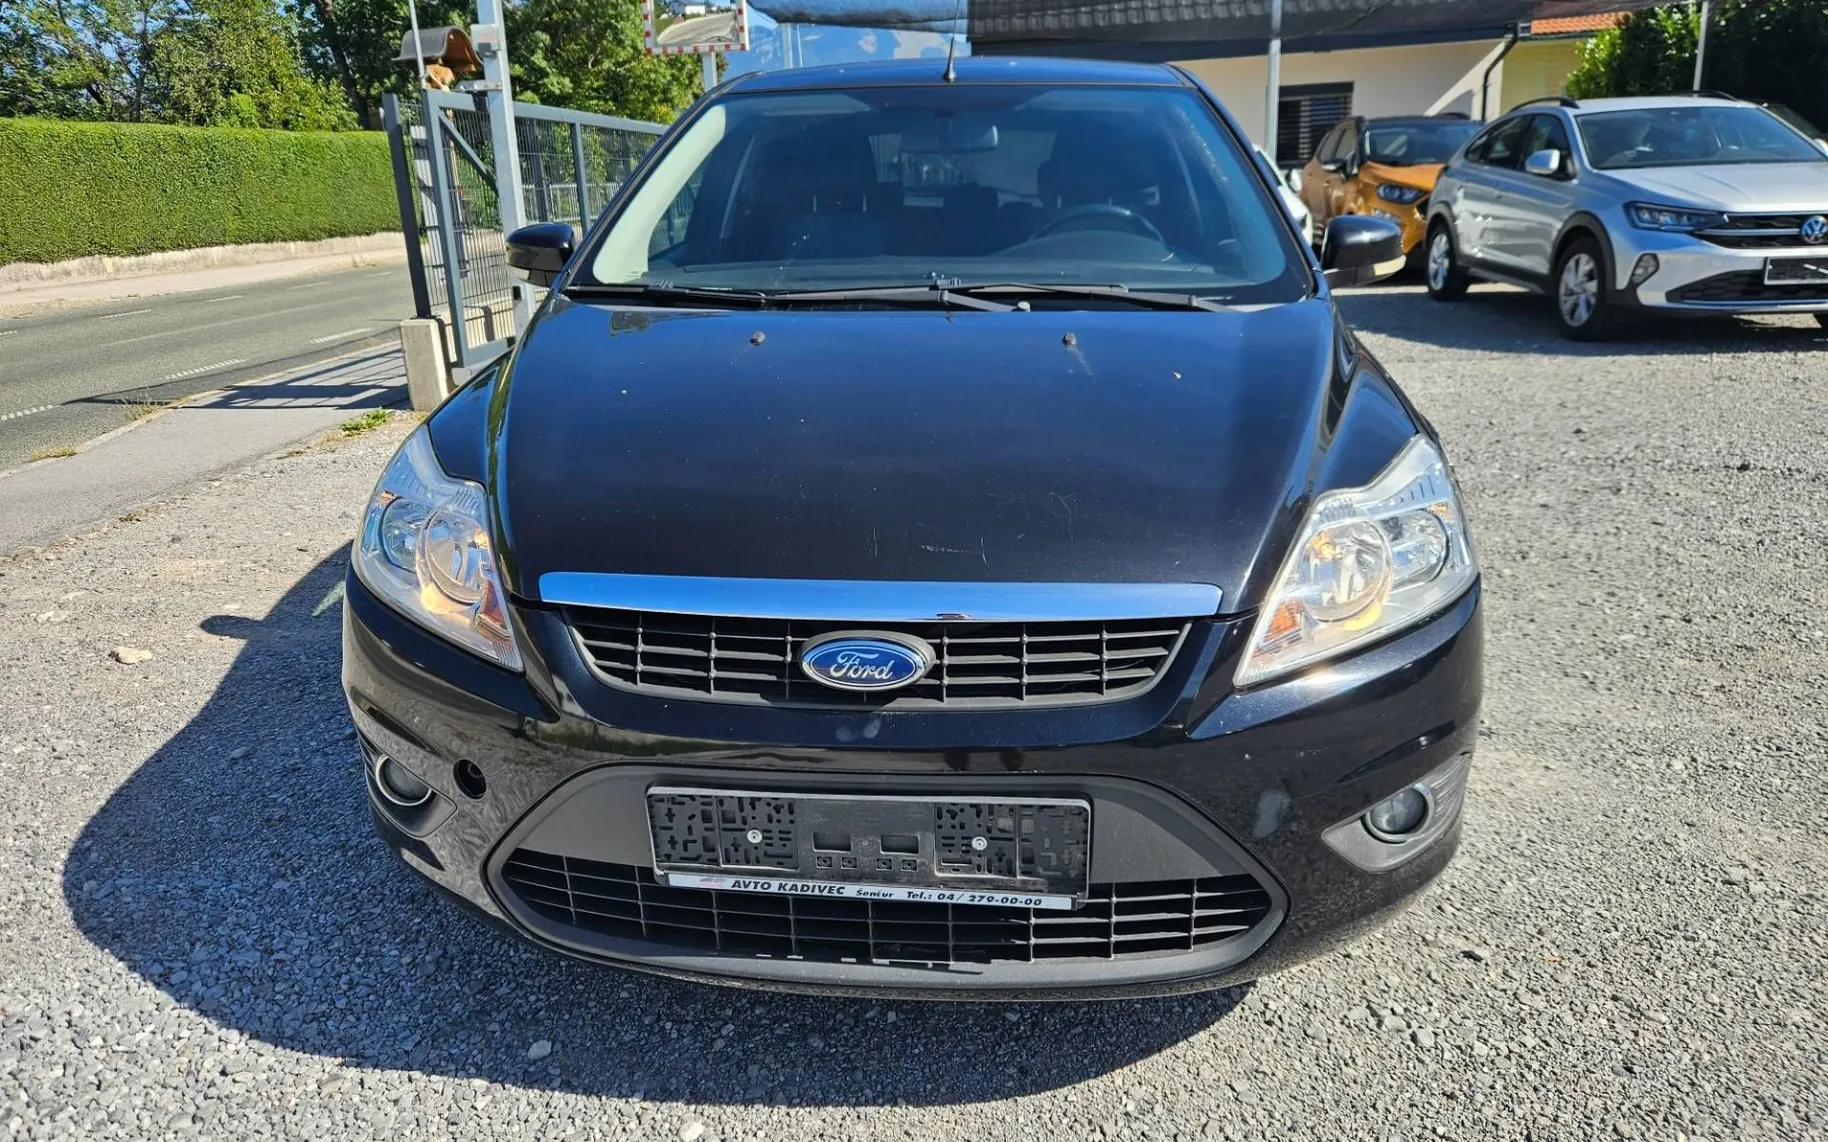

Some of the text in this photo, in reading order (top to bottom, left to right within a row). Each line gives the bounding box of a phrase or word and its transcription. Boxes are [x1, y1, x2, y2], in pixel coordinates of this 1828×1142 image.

[829, 651, 895, 679] Ford
[731, 879, 771, 892] AVTO
[778, 882, 846, 895] KADIVEC
[906, 891, 932, 900] Tel.:
[968, 895, 1042, 906] 279-00-00
